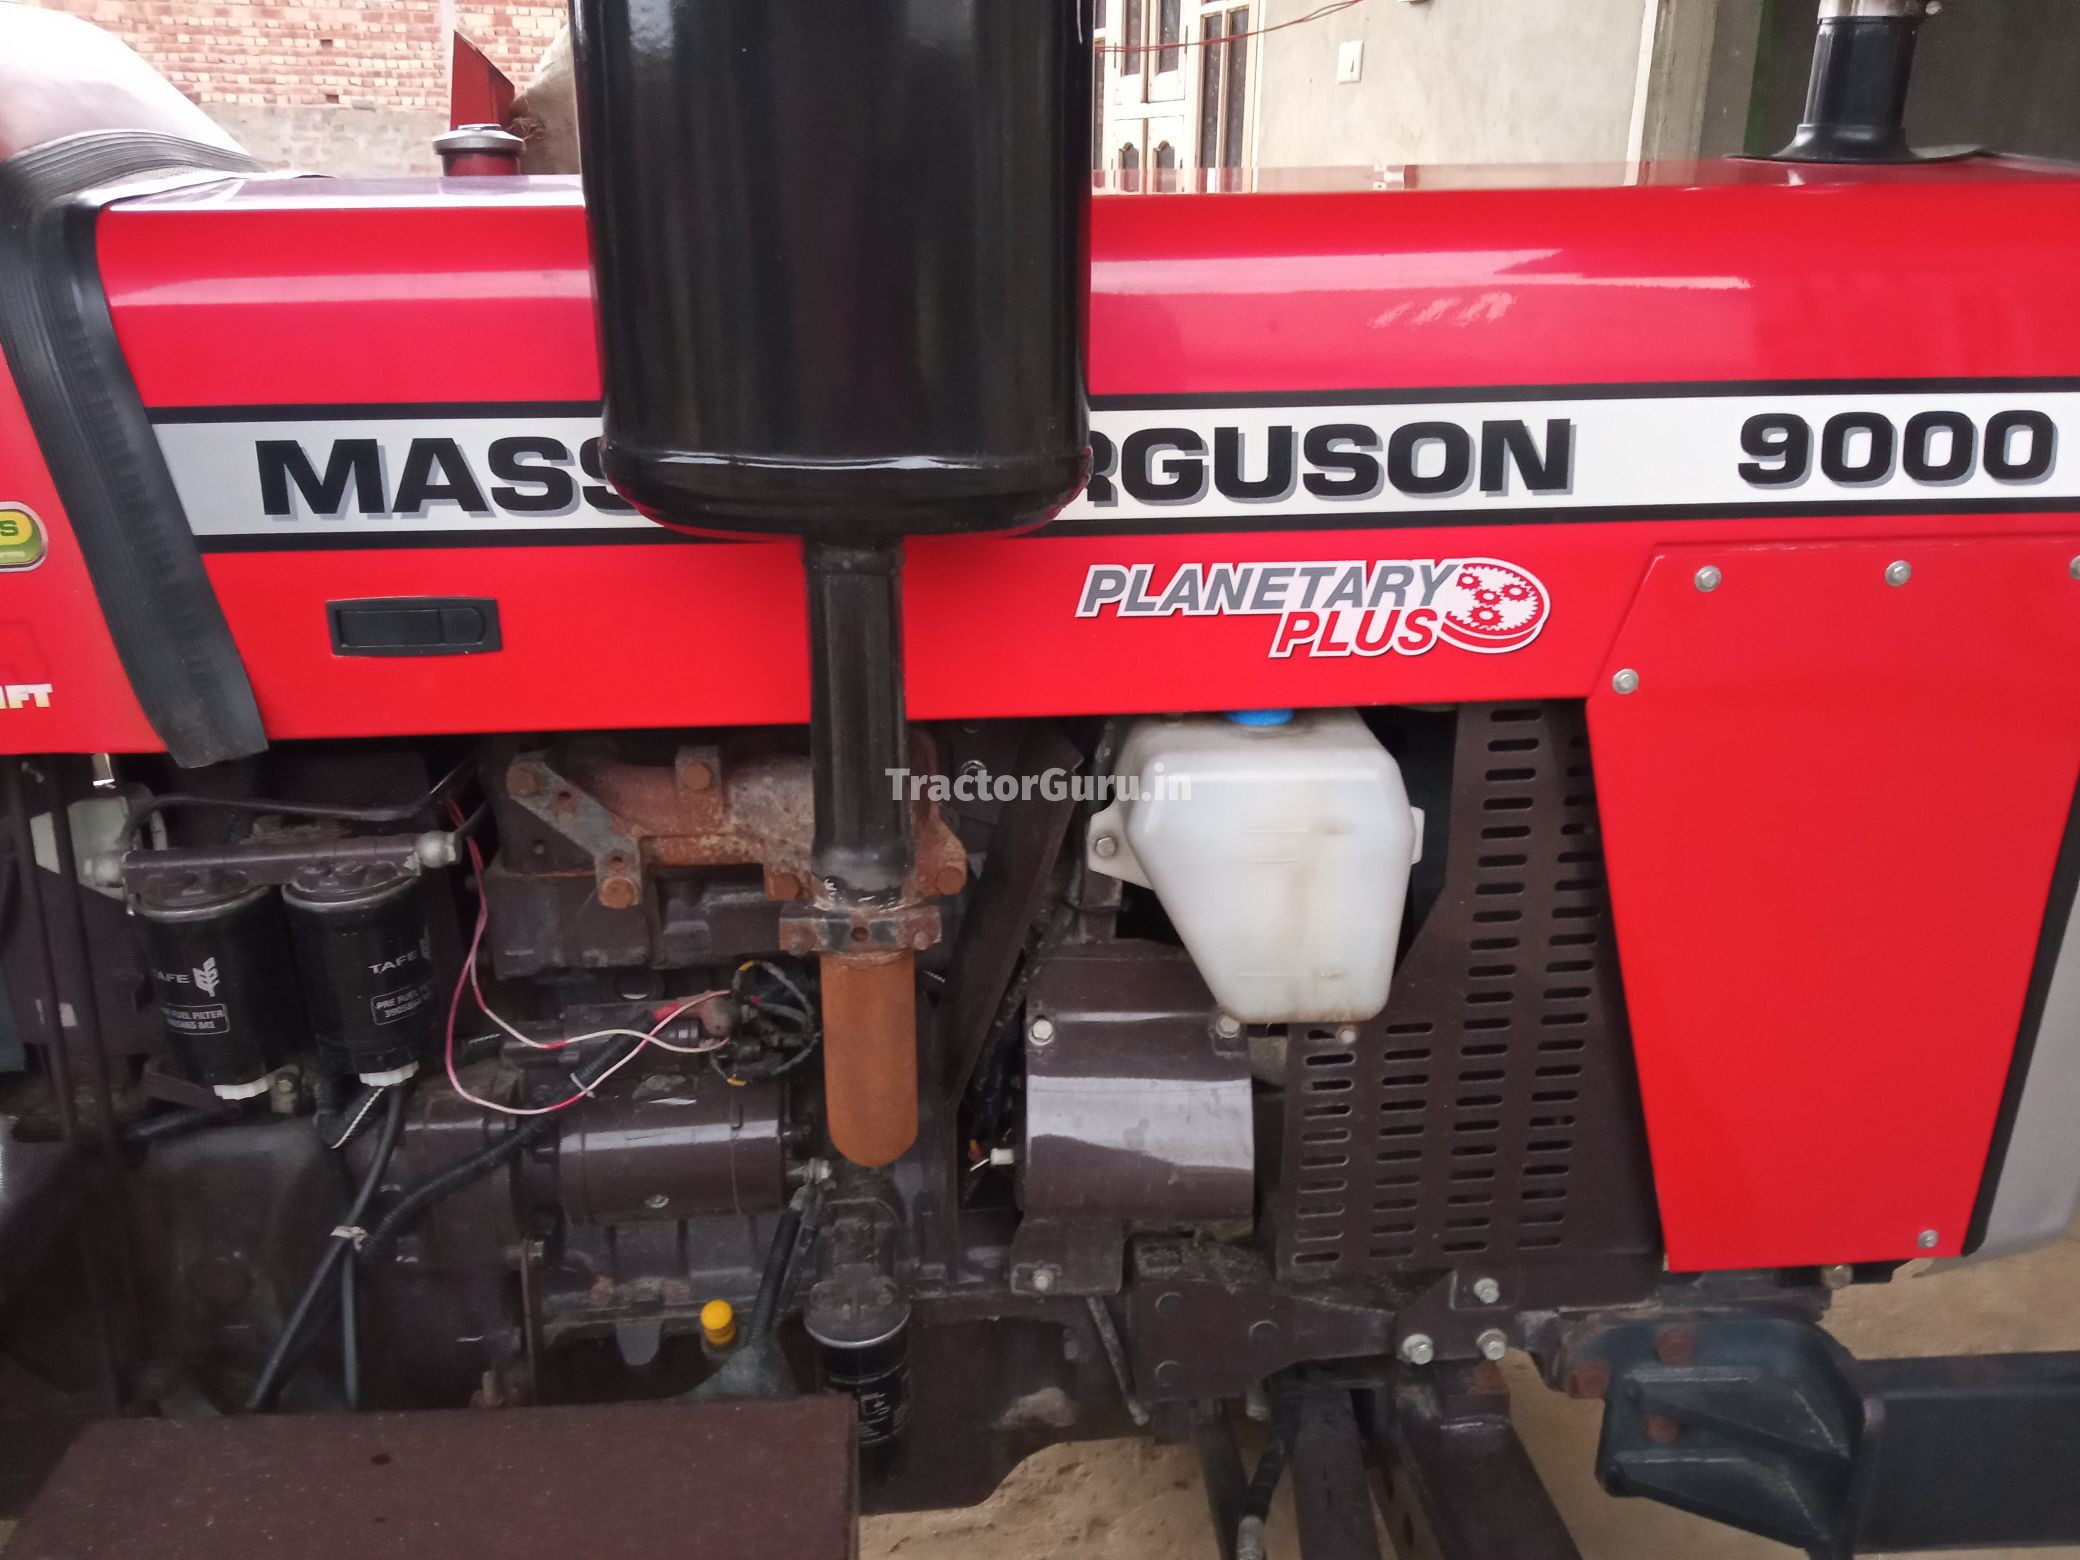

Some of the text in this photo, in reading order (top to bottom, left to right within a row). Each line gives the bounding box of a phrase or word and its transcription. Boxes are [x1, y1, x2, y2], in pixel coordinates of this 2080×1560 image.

[1738, 409, 2059, 489] 9000
[1079, 560, 1461, 616] PLANETARY
[1273, 606, 1442, 656] PLUS
[367, 950, 418, 975] TAFE
[192, 1009, 224, 1020] FILTER
